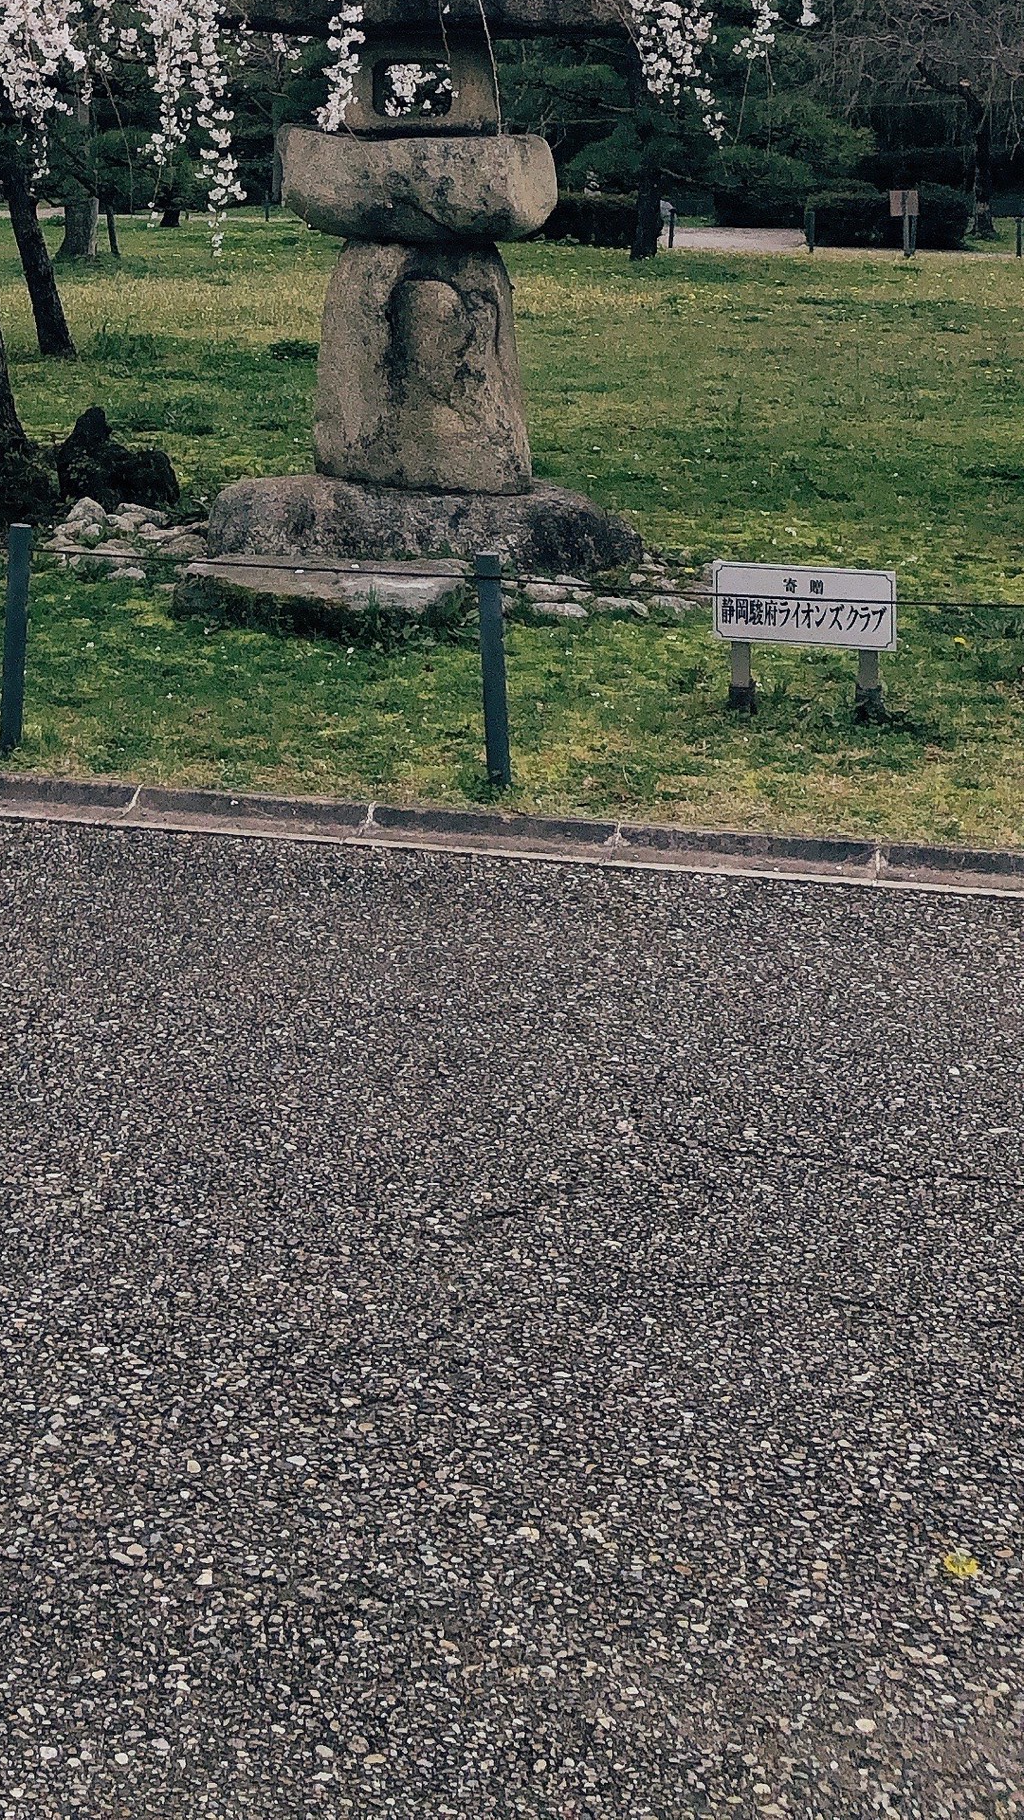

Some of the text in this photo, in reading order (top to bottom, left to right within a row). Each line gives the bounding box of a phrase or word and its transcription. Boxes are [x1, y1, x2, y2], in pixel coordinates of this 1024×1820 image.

[782, 577, 824, 594] 寄贈
[721, 596, 887, 632] 静岡駿府ライオンズクラブ
